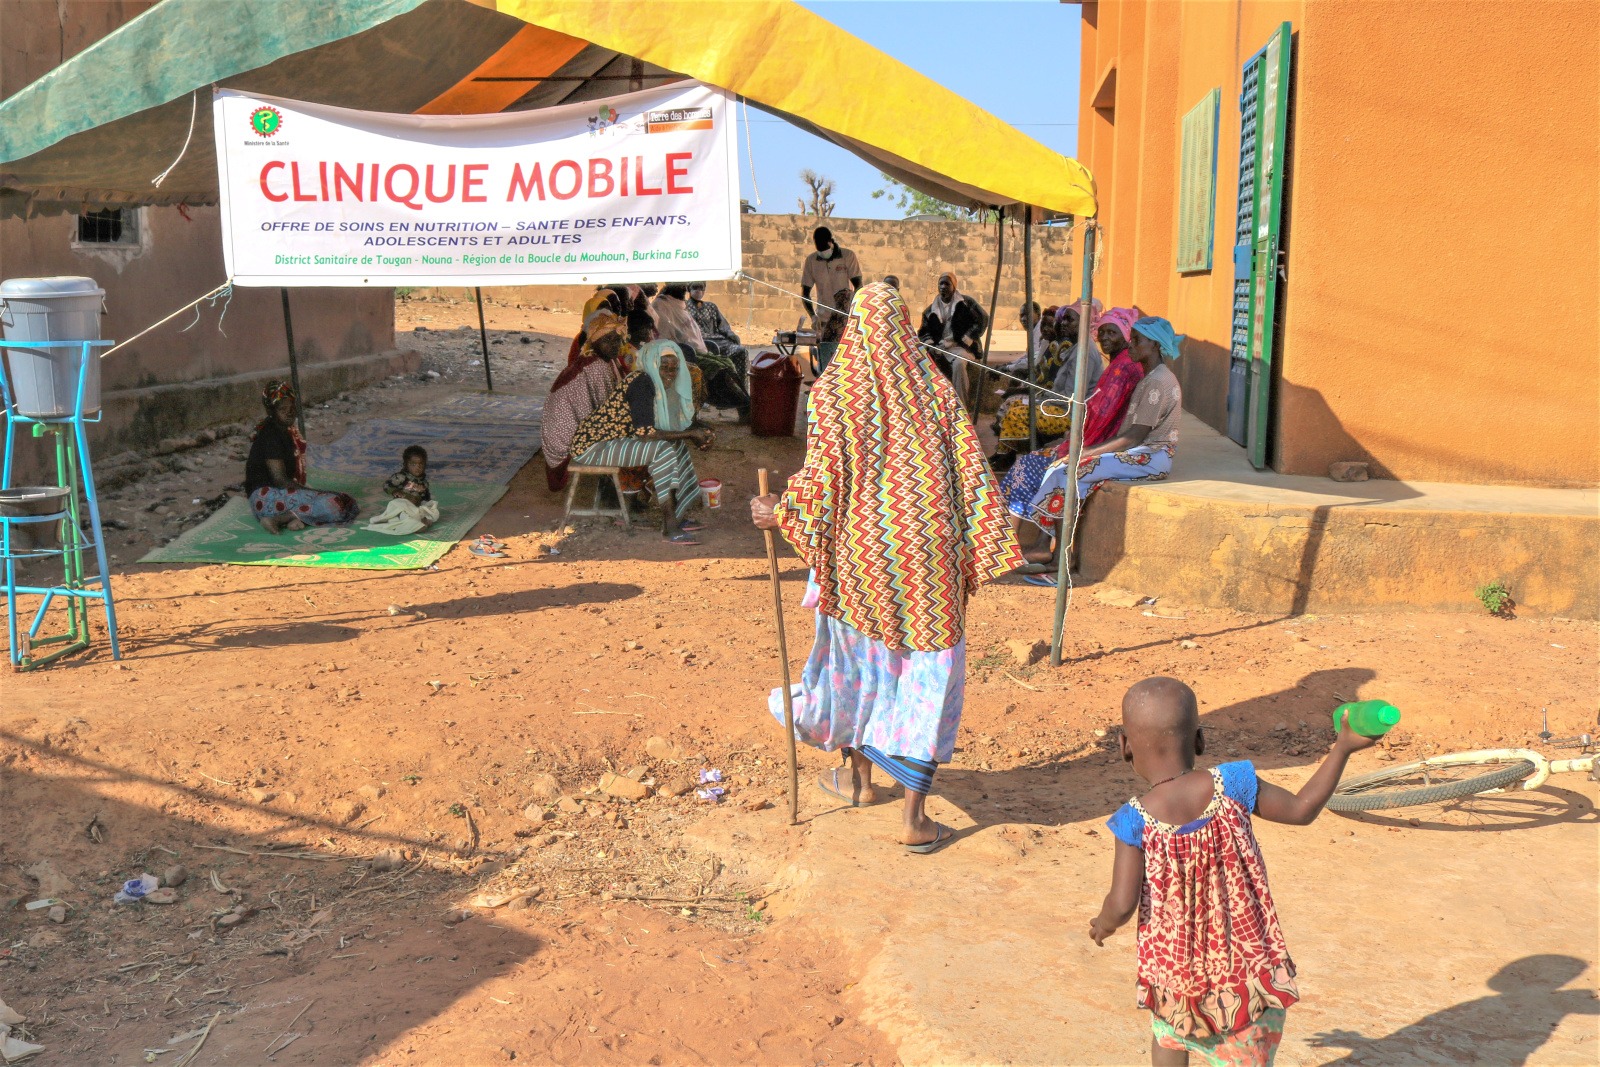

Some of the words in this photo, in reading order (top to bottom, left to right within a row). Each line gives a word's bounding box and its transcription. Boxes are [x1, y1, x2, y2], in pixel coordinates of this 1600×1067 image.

[651, 112, 669, 122] Terre
[670, 111, 682, 120] des
[683, 110, 710, 120] hoes
[260, 160, 488, 210] CLINIQUE
[506, 152, 693, 202] MOBILE
[261, 222, 310, 232] OFFRE
[314, 222, 334, 232] DE
[339, 222, 384, 232] SOINS
[389, 222, 409, 232] EN
[414, 222, 498, 232] NUTRITION
[516, 220, 570, 230] SANTE
[574, 218, 607, 229] DES
[612, 215, 691, 227] ENFANTS,
[364, 236, 478, 246] ADOLESCENTS
[483, 237, 503, 246] ET
[507, 234, 582, 245] ADULTES
[275, 255, 310, 264] District
[314, 255, 358, 264] Sanitaire
[361, 255, 372, 264] de
[376, 255, 412, 266] Tougan
[422, 255, 452, 264] Nouna
[463, 254, 496, 266] Région
[499, 254, 511, 264] de
[515, 254, 524, 263] la
[528, 253, 561, 263] Boucle
[564, 253, 576, 262] du
[580, 252, 629, 262] Mouhoun,
[632, 250, 671, 260] Burkina
[675, 249, 699, 259] Faso
